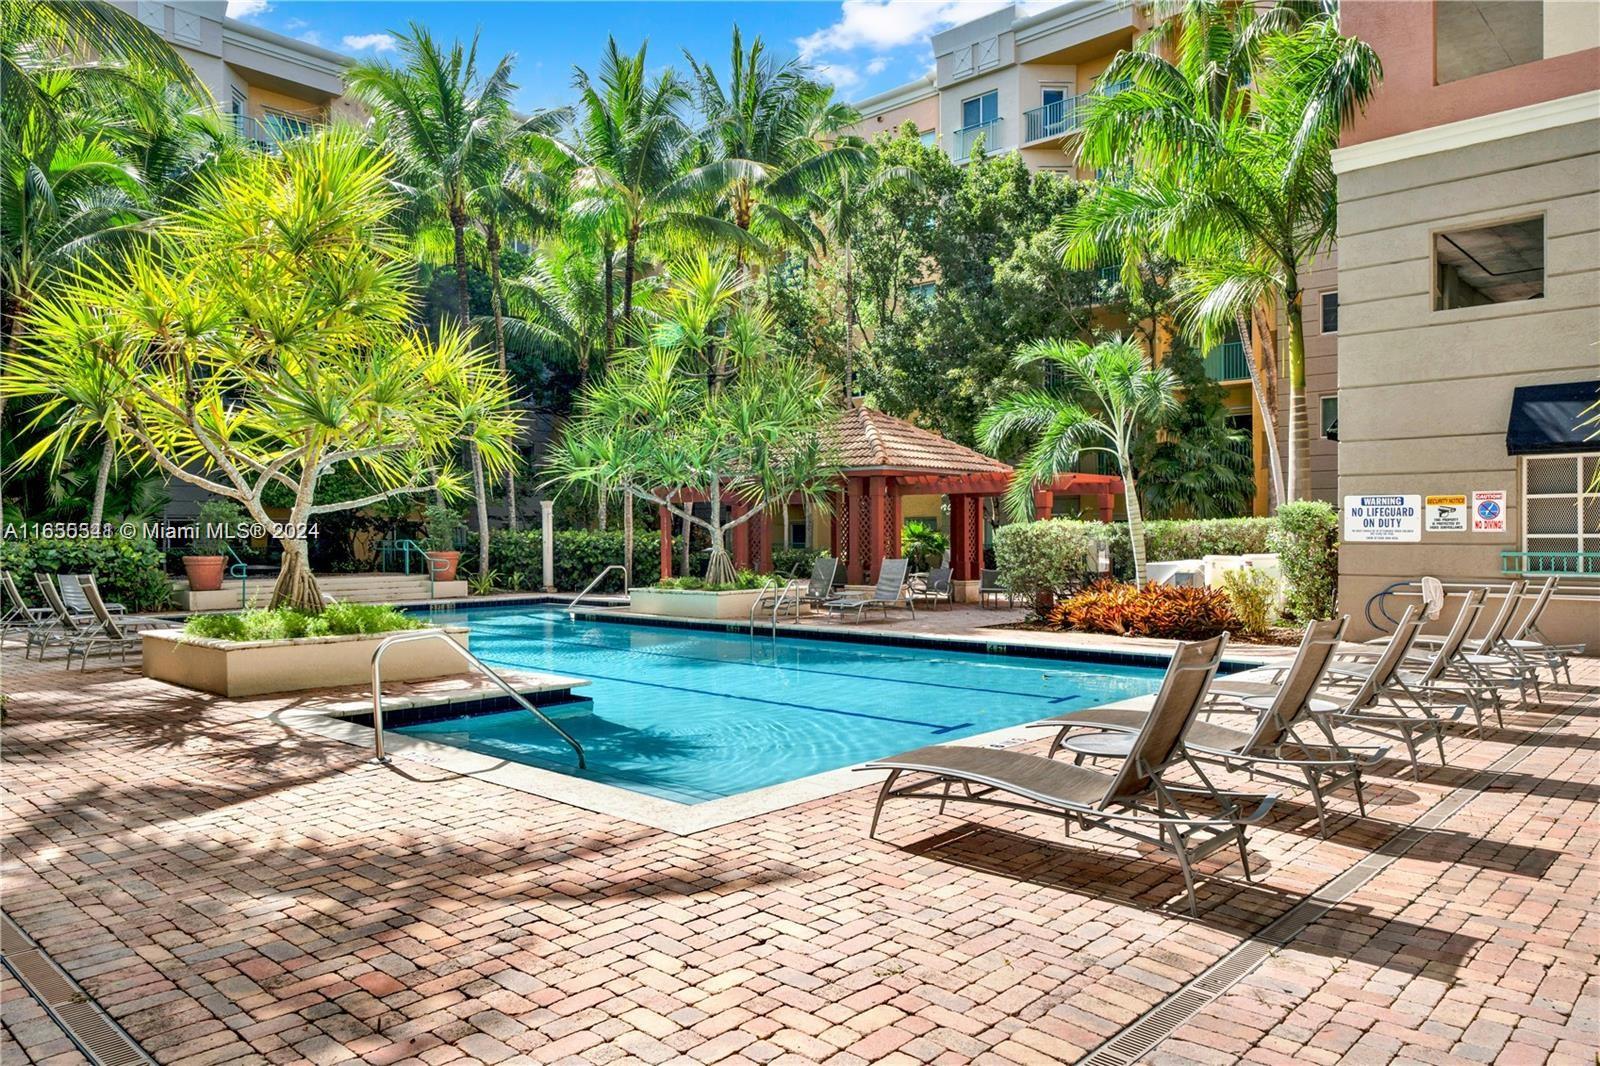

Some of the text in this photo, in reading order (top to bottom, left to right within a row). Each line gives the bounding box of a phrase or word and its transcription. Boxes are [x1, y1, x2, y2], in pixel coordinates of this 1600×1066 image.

[1363, 497, 1402, 506] WARNING
[1351, 507, 1414, 517] NO LIFEGUARD
[1363, 518, 1402, 528] ON DUTY
[1475, 520, 1482, 529] NO
